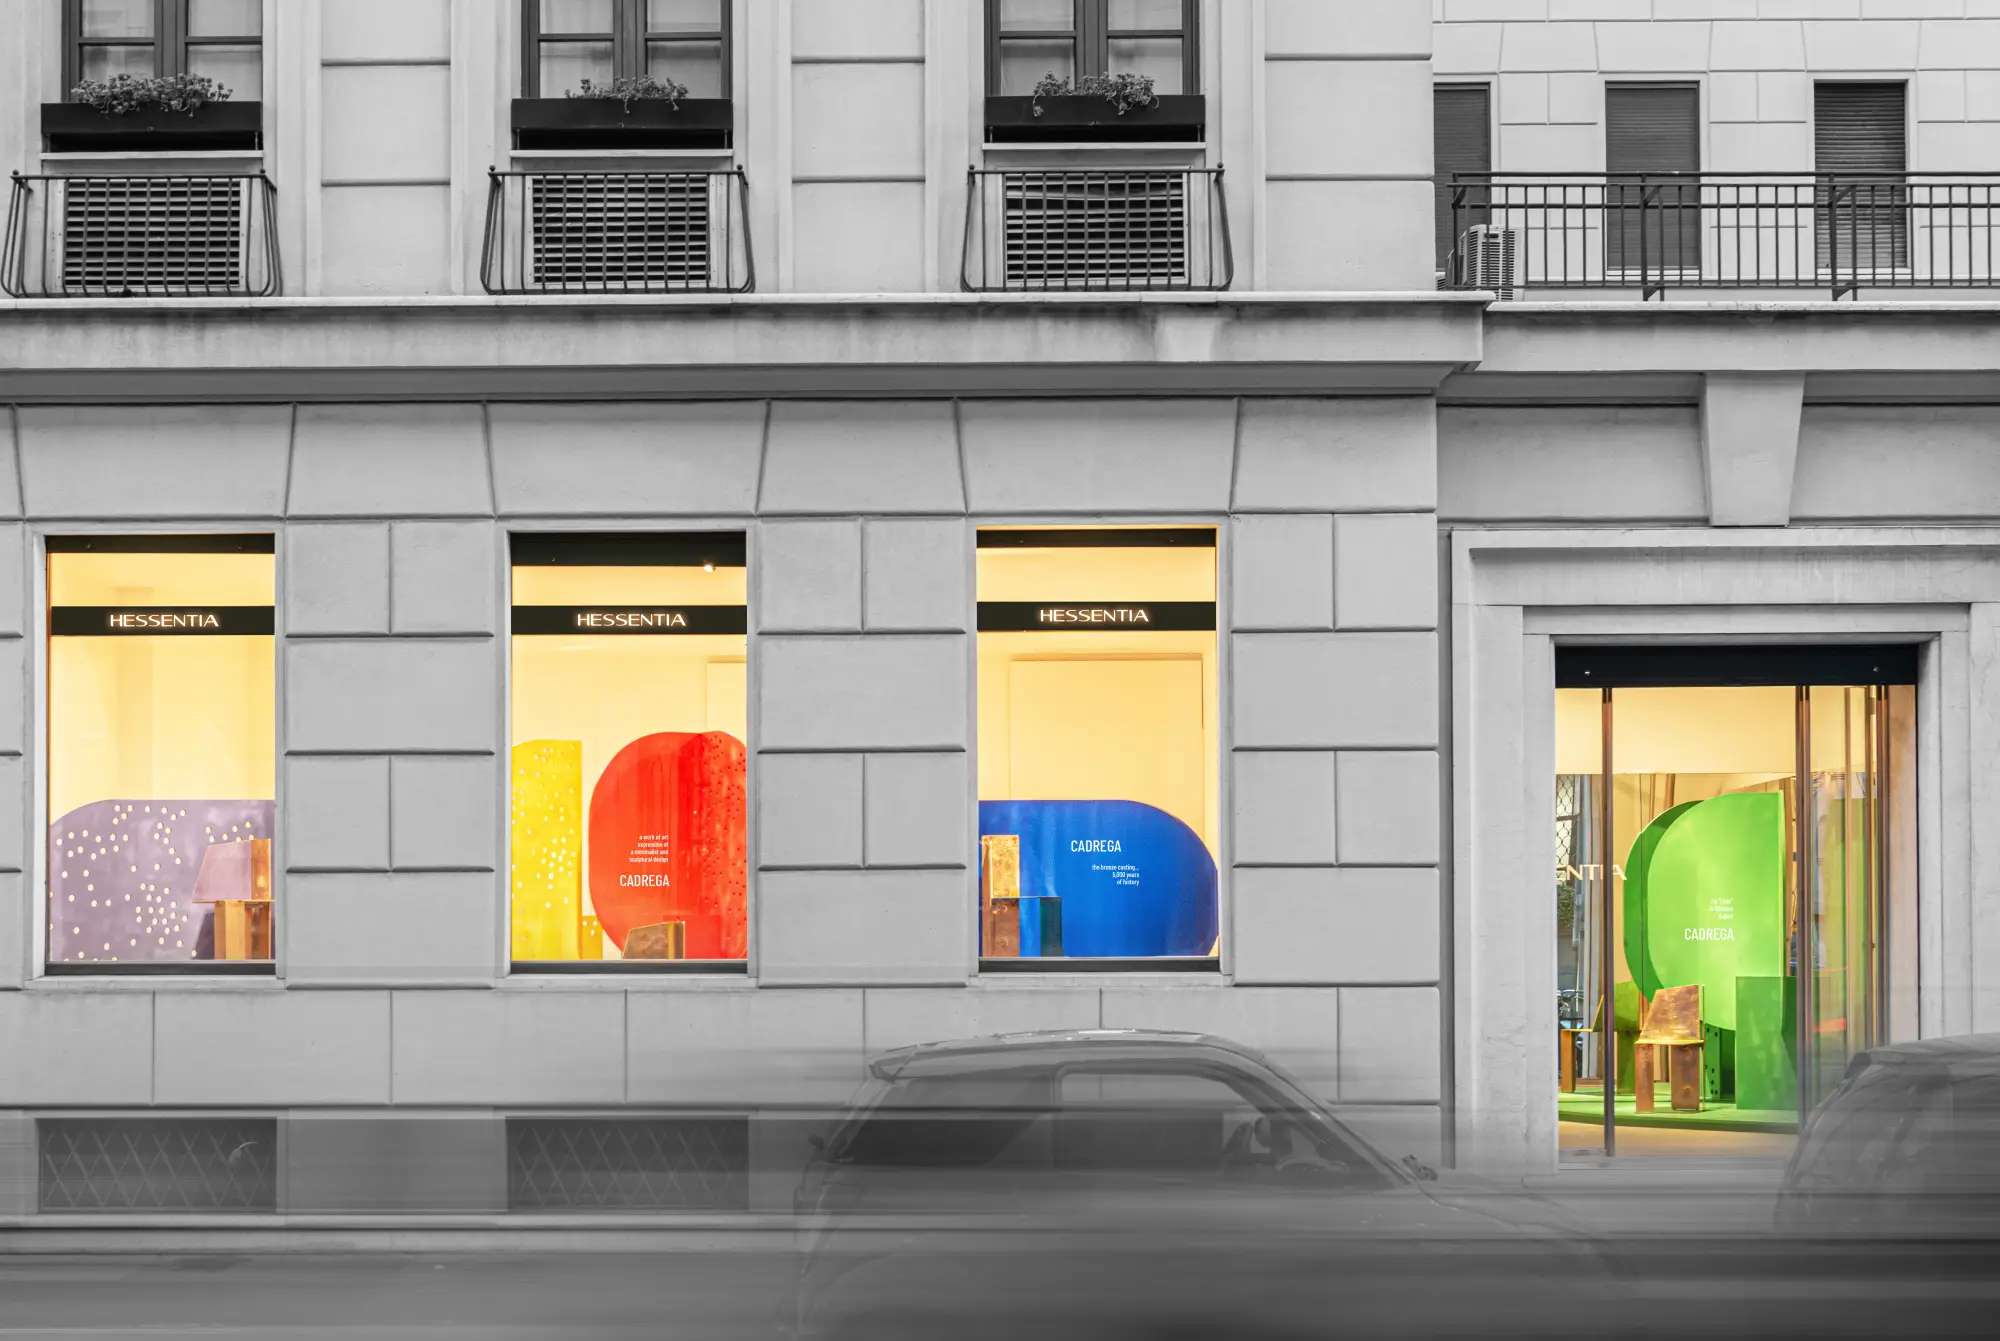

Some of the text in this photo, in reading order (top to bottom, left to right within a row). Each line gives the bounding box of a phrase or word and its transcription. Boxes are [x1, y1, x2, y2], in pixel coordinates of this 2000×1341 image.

[110, 614, 219, 627] HESSENTIA
[577, 613, 687, 626] HESSENTIA
[1040, 609, 1149, 622] HESSENTIA
[1071, 839, 1122, 853] CADREGA
[620, 874, 670, 887] CADREGA
[1684, 927, 1734, 941] CADREGA
